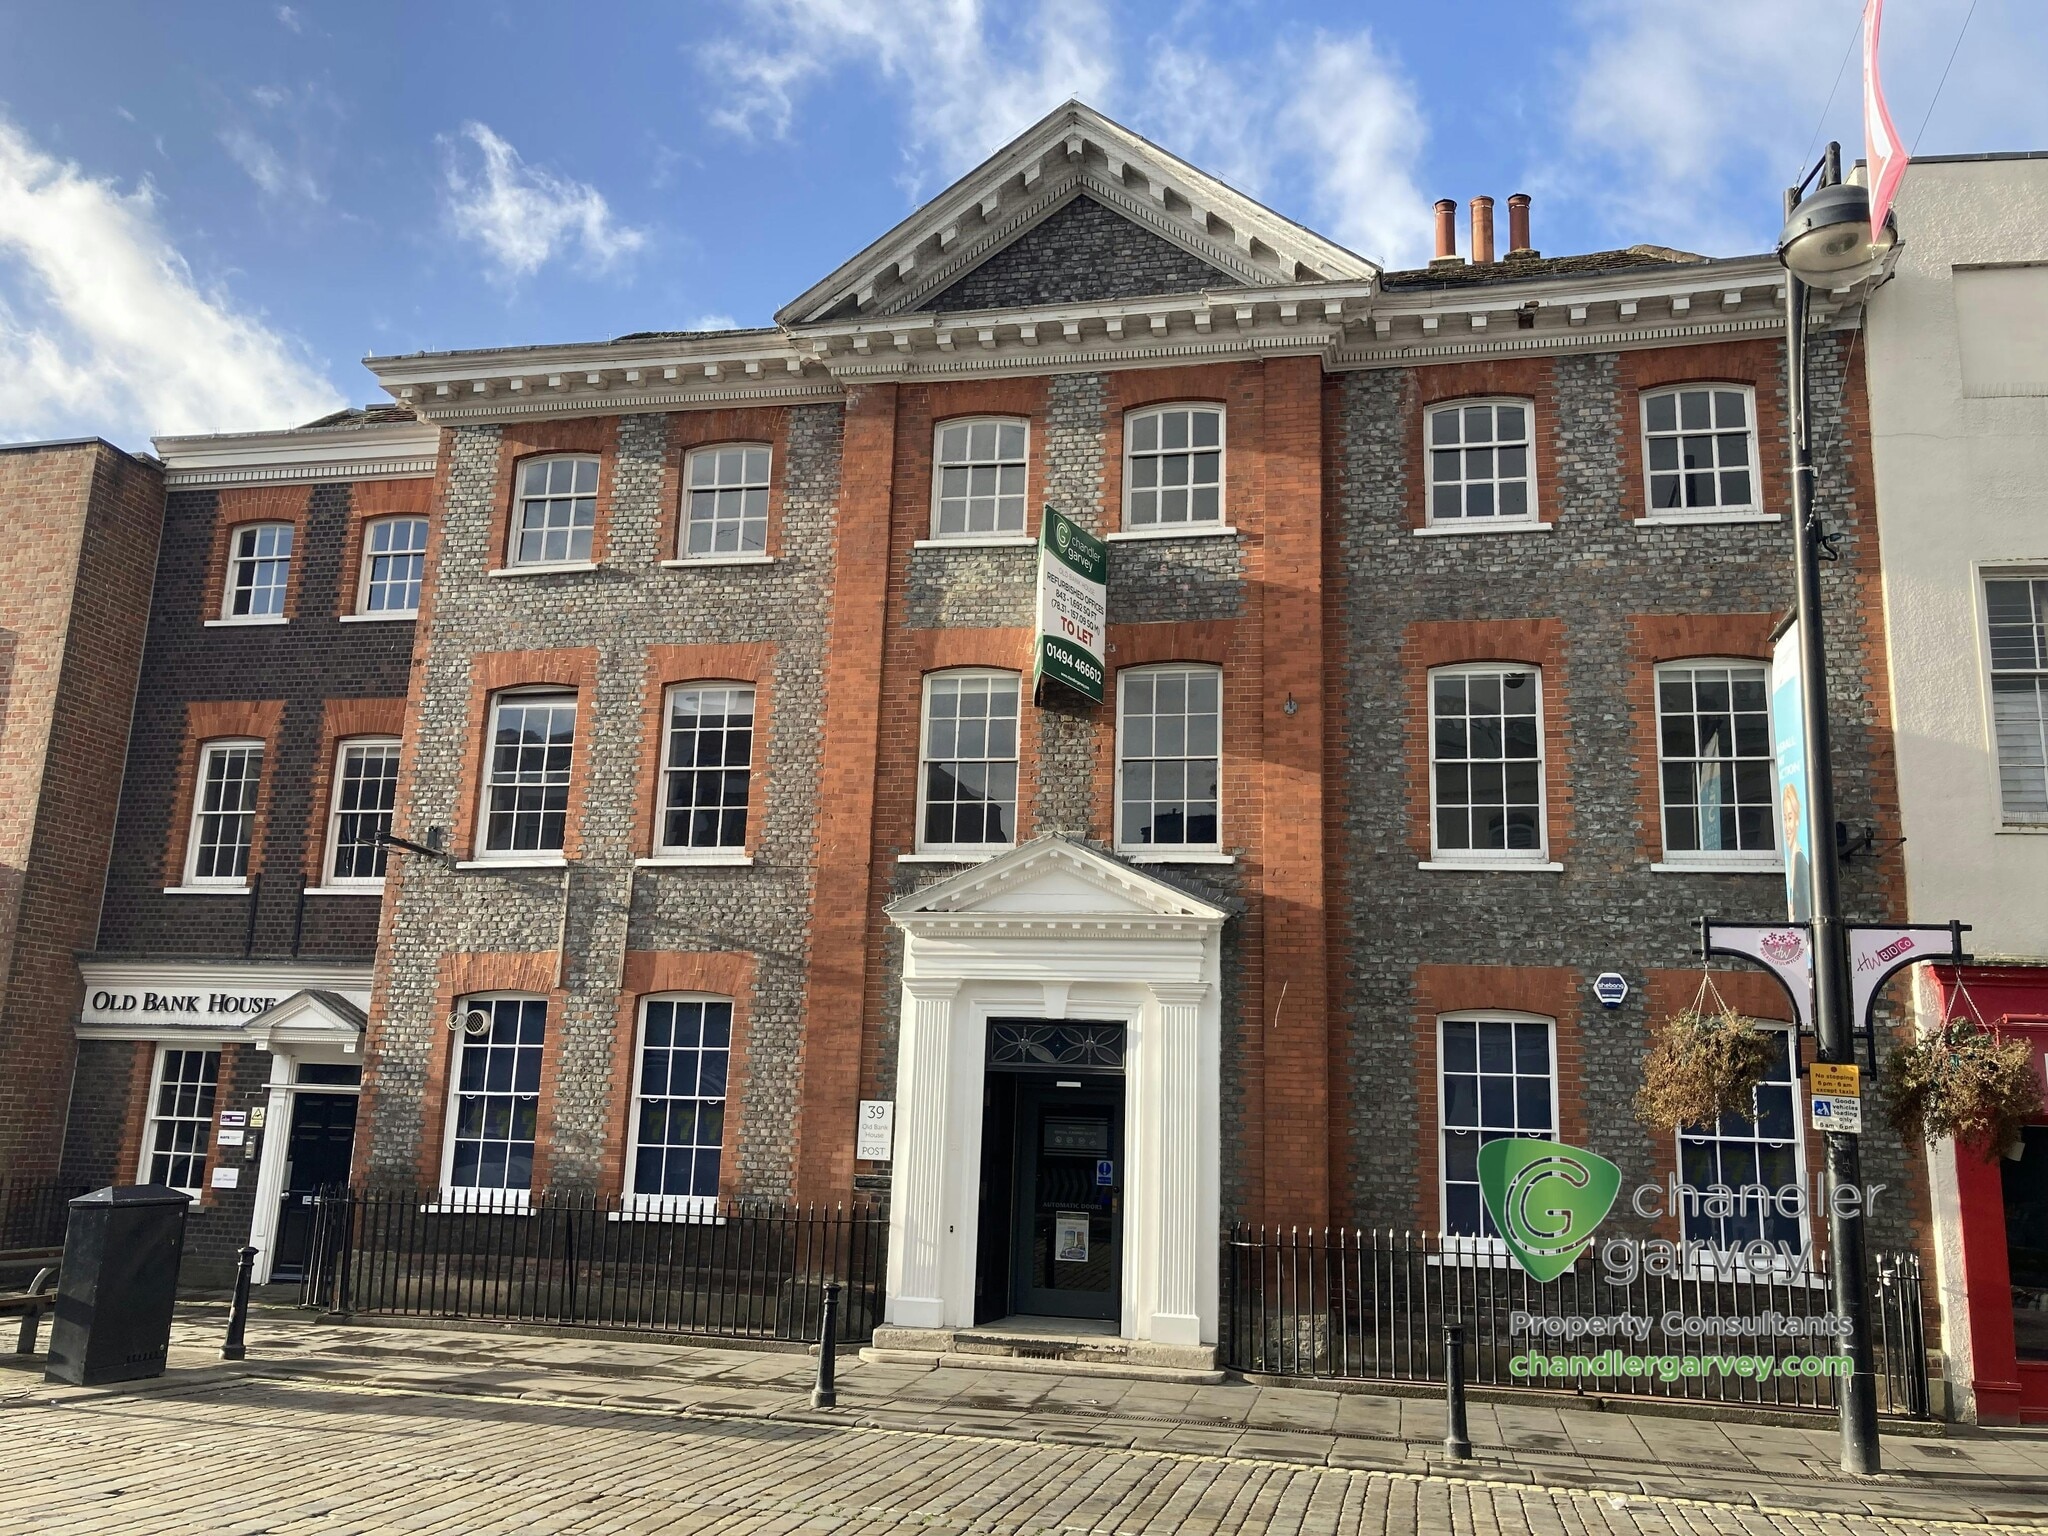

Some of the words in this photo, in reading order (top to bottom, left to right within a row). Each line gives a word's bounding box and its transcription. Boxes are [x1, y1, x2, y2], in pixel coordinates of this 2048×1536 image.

[1068, 548, 1093, 573] garvey
[1072, 536, 1101, 563] chandler
[1047, 572, 1084, 600] REFURBISHED
[1085, 596, 1104, 615] OFFICES
[1056, 589, 1066, 602] 843
[1083, 605, 1090, 617] SQ
[1091, 611, 1097, 620] FT
[1061, 616, 1075, 635] TO
[1077, 625, 1093, 647] LET
[1087, 620, 1093, 630] SQ
[1047, 642, 1073, 667] 01494
[1075, 659, 1102, 684] 466612
[1880, 945, 1899, 960] BID
[1898, 939, 1912, 950] Co
[92, 991, 137, 1011] OLD
[141, 992, 200, 1012] BANK
[207, 993, 276, 1014] HOUSE
[867, 1105, 885, 1119] 39
[862, 1146, 885, 1155] POST
